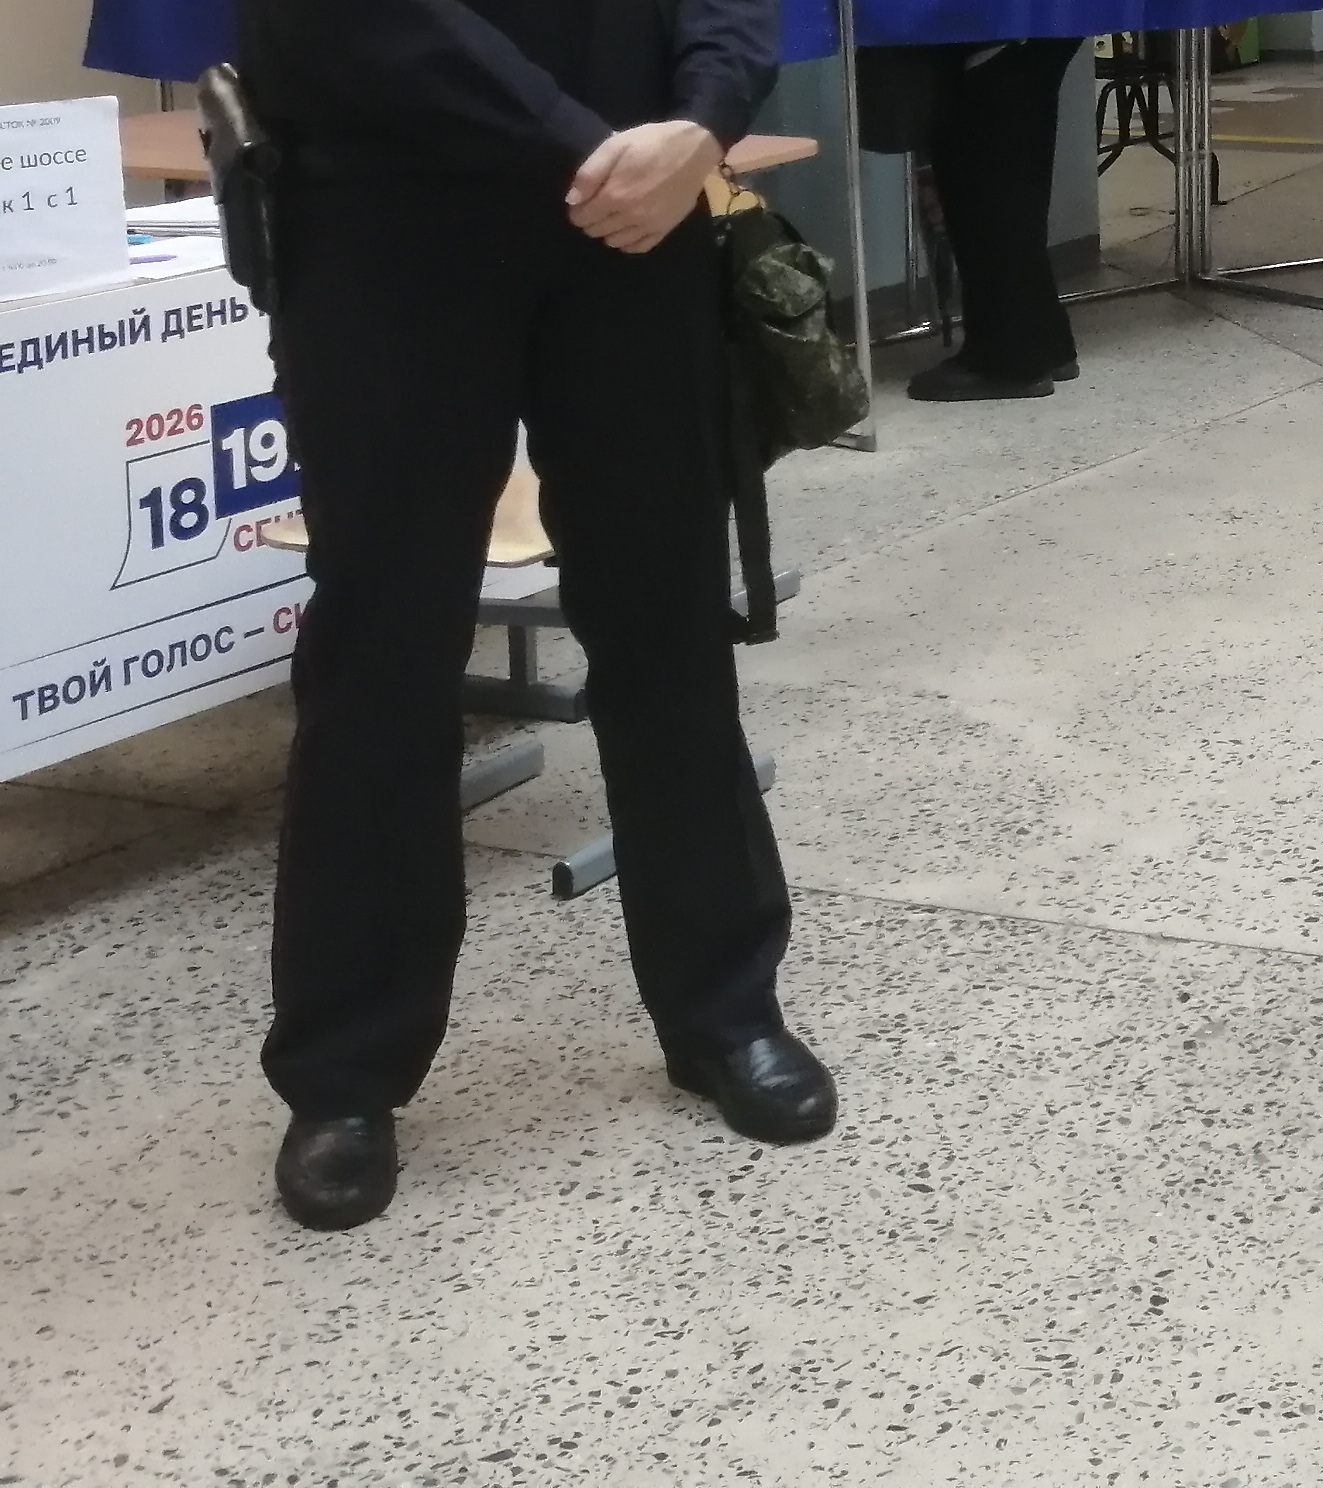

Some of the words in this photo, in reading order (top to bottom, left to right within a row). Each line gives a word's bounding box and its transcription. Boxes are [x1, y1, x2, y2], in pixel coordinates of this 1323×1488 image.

[20, 148, 88, 169] шоссе
[22, 191, 35, 211] 1
[47, 194, 59, 208] с
[65, 186, 78, 206] 1
[0, 306, 152, 374] ЕДИНЫЙ
[161, 296, 250, 343] ДЕНЬ
[125, 403, 205, 448] 2026
[221, 419, 289, 490] 19
[139, 476, 210, 551] 18
[12, 657, 112, 721] ТВОЙ
[123, 625, 236, 686] ГОЛОС
